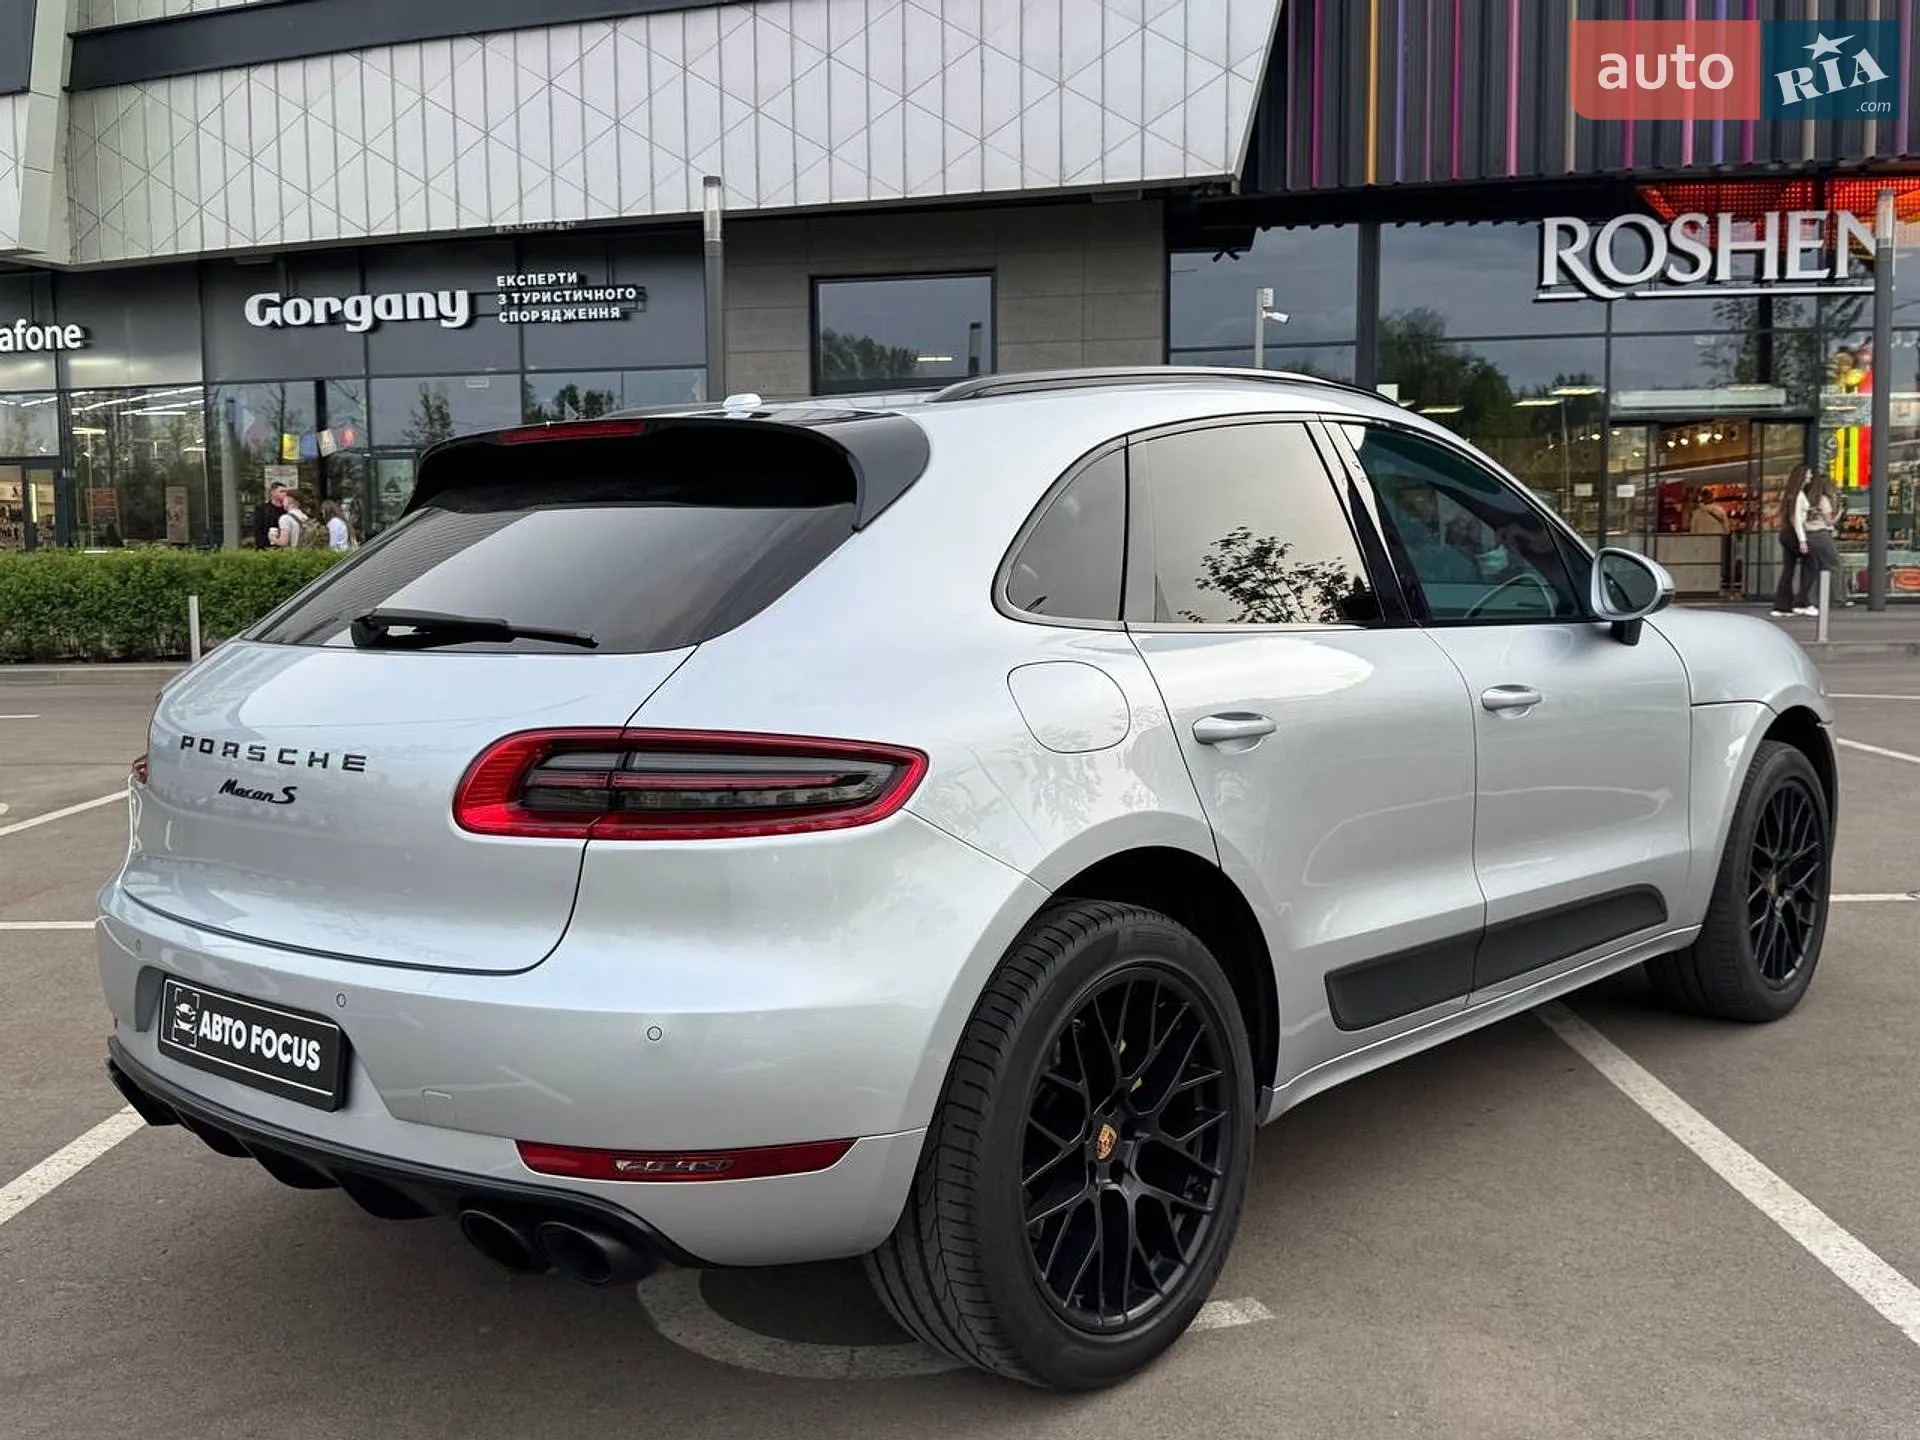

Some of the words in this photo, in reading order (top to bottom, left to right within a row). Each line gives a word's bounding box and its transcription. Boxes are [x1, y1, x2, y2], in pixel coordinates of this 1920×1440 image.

[1541, 210, 1877, 299] ROSHEN
[496, 271, 578, 287] ЕКСПЕРТИ
[511, 287, 637, 304] ТУРИСТИЧНОГО
[244, 289, 470, 333] Gorgany
[499, 306, 620, 323] СПОРЯДЖЕННЯ
[0, 318, 84, 352] afone
[180, 735, 367, 772] PORSCHE
[219, 778, 275, 802] Macan
[271, 786, 298, 804] S
[250, 1024, 321, 1072] FOCUS
